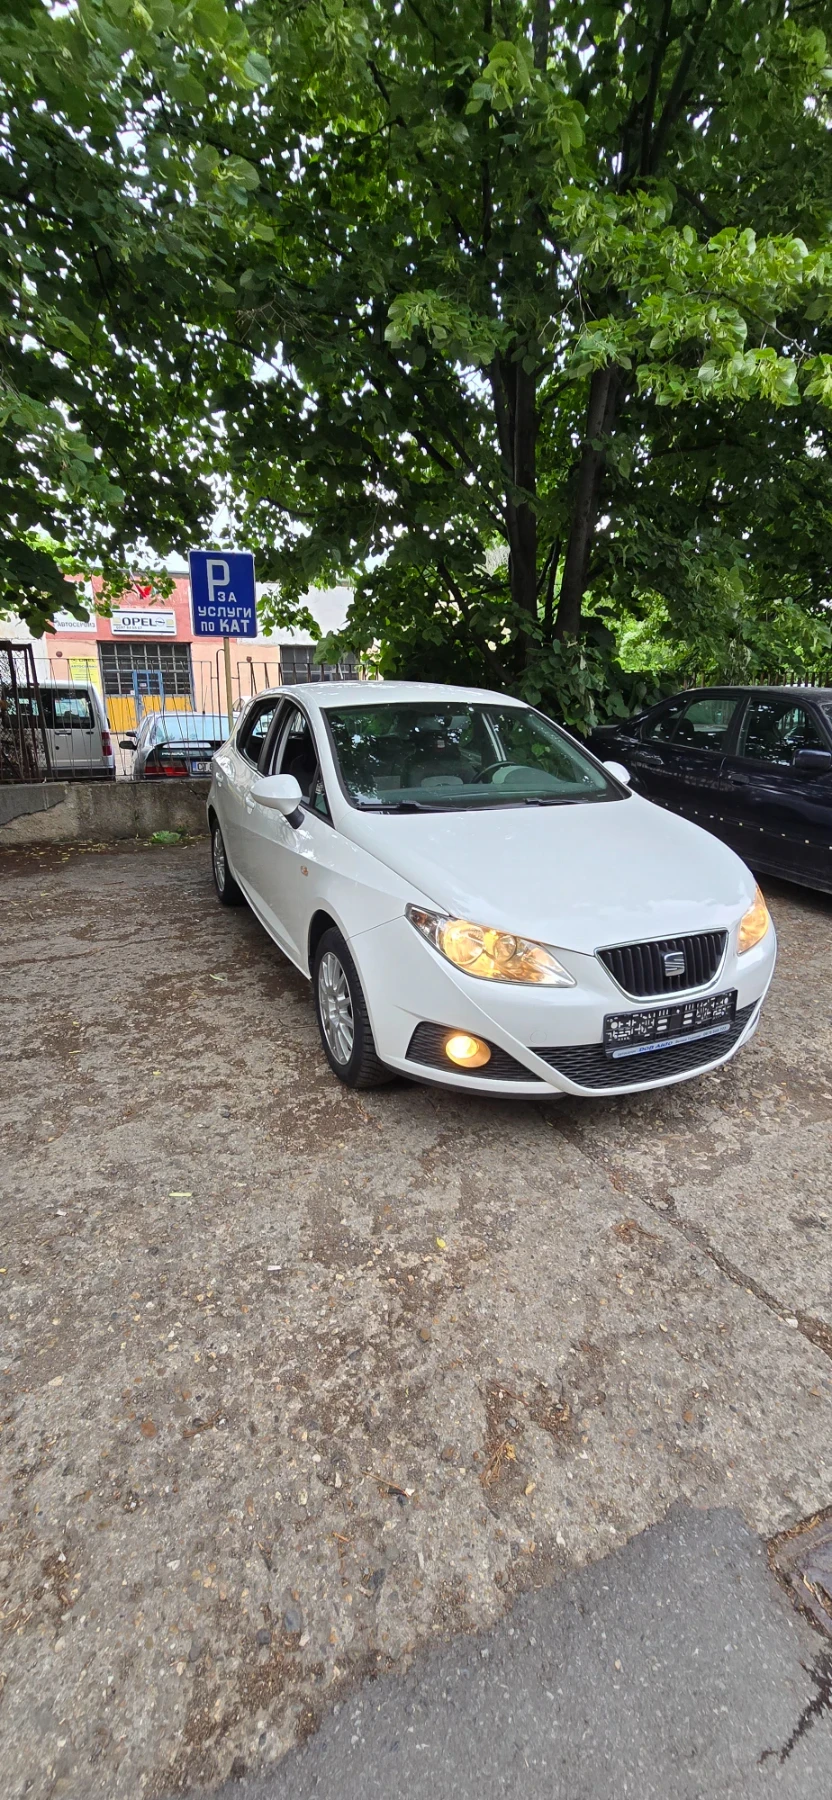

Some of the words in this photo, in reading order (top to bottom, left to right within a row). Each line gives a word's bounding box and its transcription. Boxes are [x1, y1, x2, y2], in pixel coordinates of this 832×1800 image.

[217, 591, 237, 602] ЗА
[198, 606, 252, 618] УСЛУГИ
[122, 617, 157, 627] OPEL
[220, 619, 250, 633] КАТ
